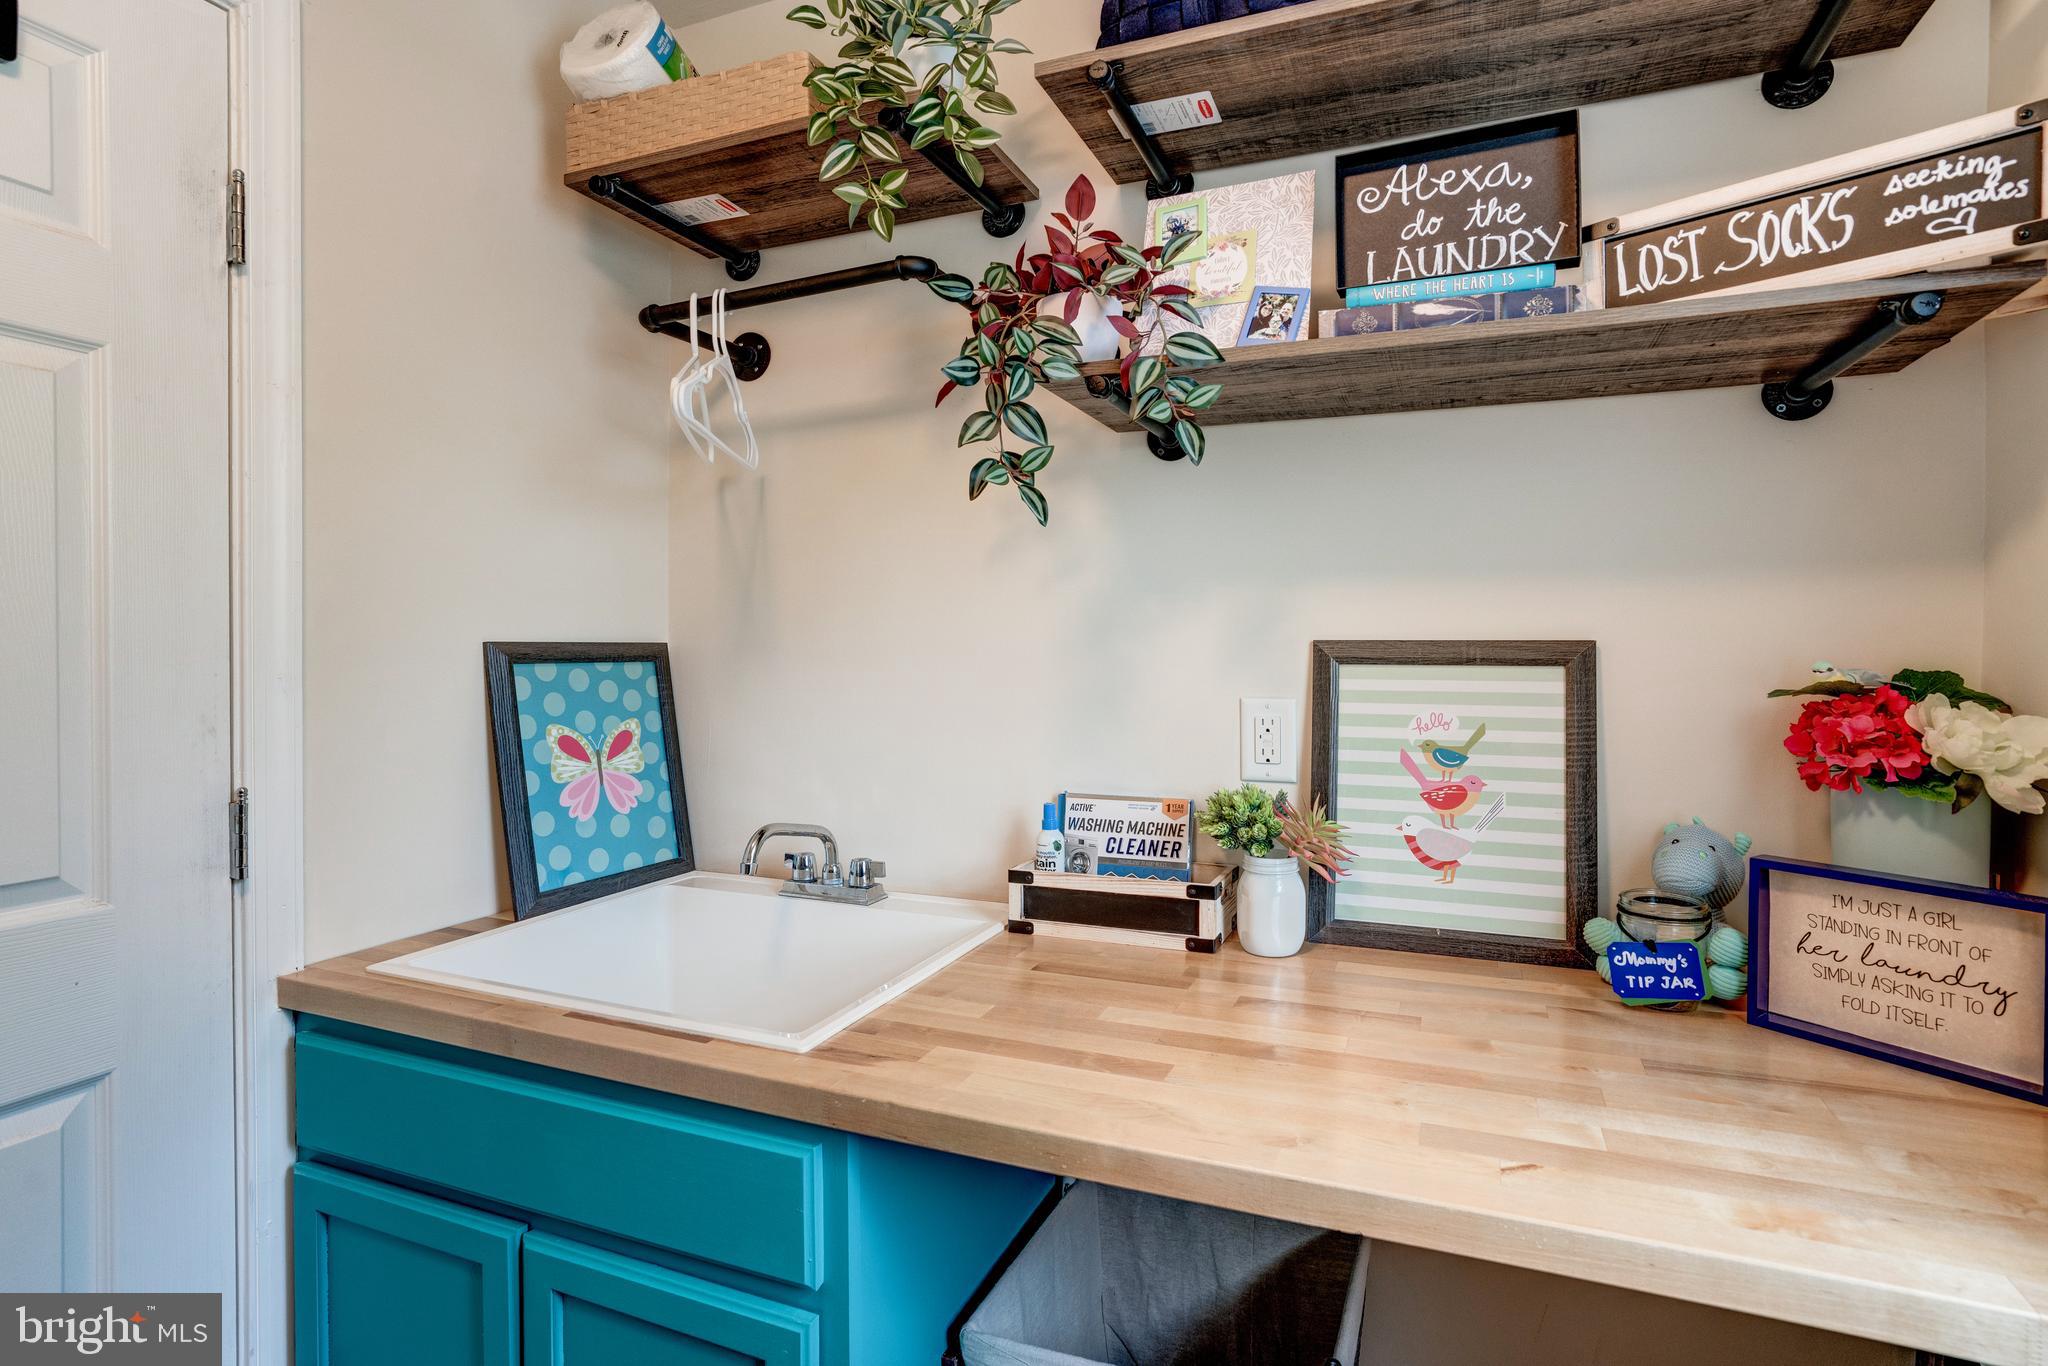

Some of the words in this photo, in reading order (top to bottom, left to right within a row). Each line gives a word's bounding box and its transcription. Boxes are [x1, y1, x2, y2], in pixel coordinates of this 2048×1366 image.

[1357, 162, 1533, 213] Alexa,
[1883, 154, 2018, 197] seeking
[1401, 209, 1444, 241] do
[1464, 197, 1526, 232] the
[1884, 177, 2030, 227] solemates
[1365, 221, 1569, 285] LAUNDRY
[1613, 226, 1707, 297] LOST
[1714, 185, 1859, 275] SOCKS
[1372, 283, 1418, 300] WHERE
[1424, 280, 1448, 294] THE
[1452, 273, 1495, 291] HEART
[1501, 272, 1516, 286] IS
[1412, 712, 1453, 735] hello
[1069, 802, 1094, 813] ACTIVE
[1165, 803, 1171, 813] 1
[1067, 817, 1124, 834] WASHING
[1126, 820, 1187, 838] MACHINE
[1105, 836, 1183, 859] CLEANER
[1832, 894, 1854, 908] I'M
[1857, 899, 1903, 919] JUST
[1908, 906, 1918, 922] A
[1924, 911, 1963, 931] GIRL
[1807, 914, 1880, 940] STANDING
[1885, 929, 1902, 945] IN
[1907, 934, 1963, 958] FRONT
[1969, 946, 1993, 962] OF
[1613, 951, 1688, 973] Mommy's
[1797, 931, 1849, 962] her
[1861, 943, 2018, 1017] laundry
[1625, 974, 1654, 988] TIP
[1661, 976, 1696, 989] JAR
[1812, 962, 1866, 988] SIMPLY
[1871, 975, 1934, 1003] ASKING
[1941, 993, 1957, 1008] IT
[1963, 997, 1984, 1015] TO
[1841, 995, 1881, 1015] FOLD
[1886, 1004, 1949, 1032] ITSELF.
